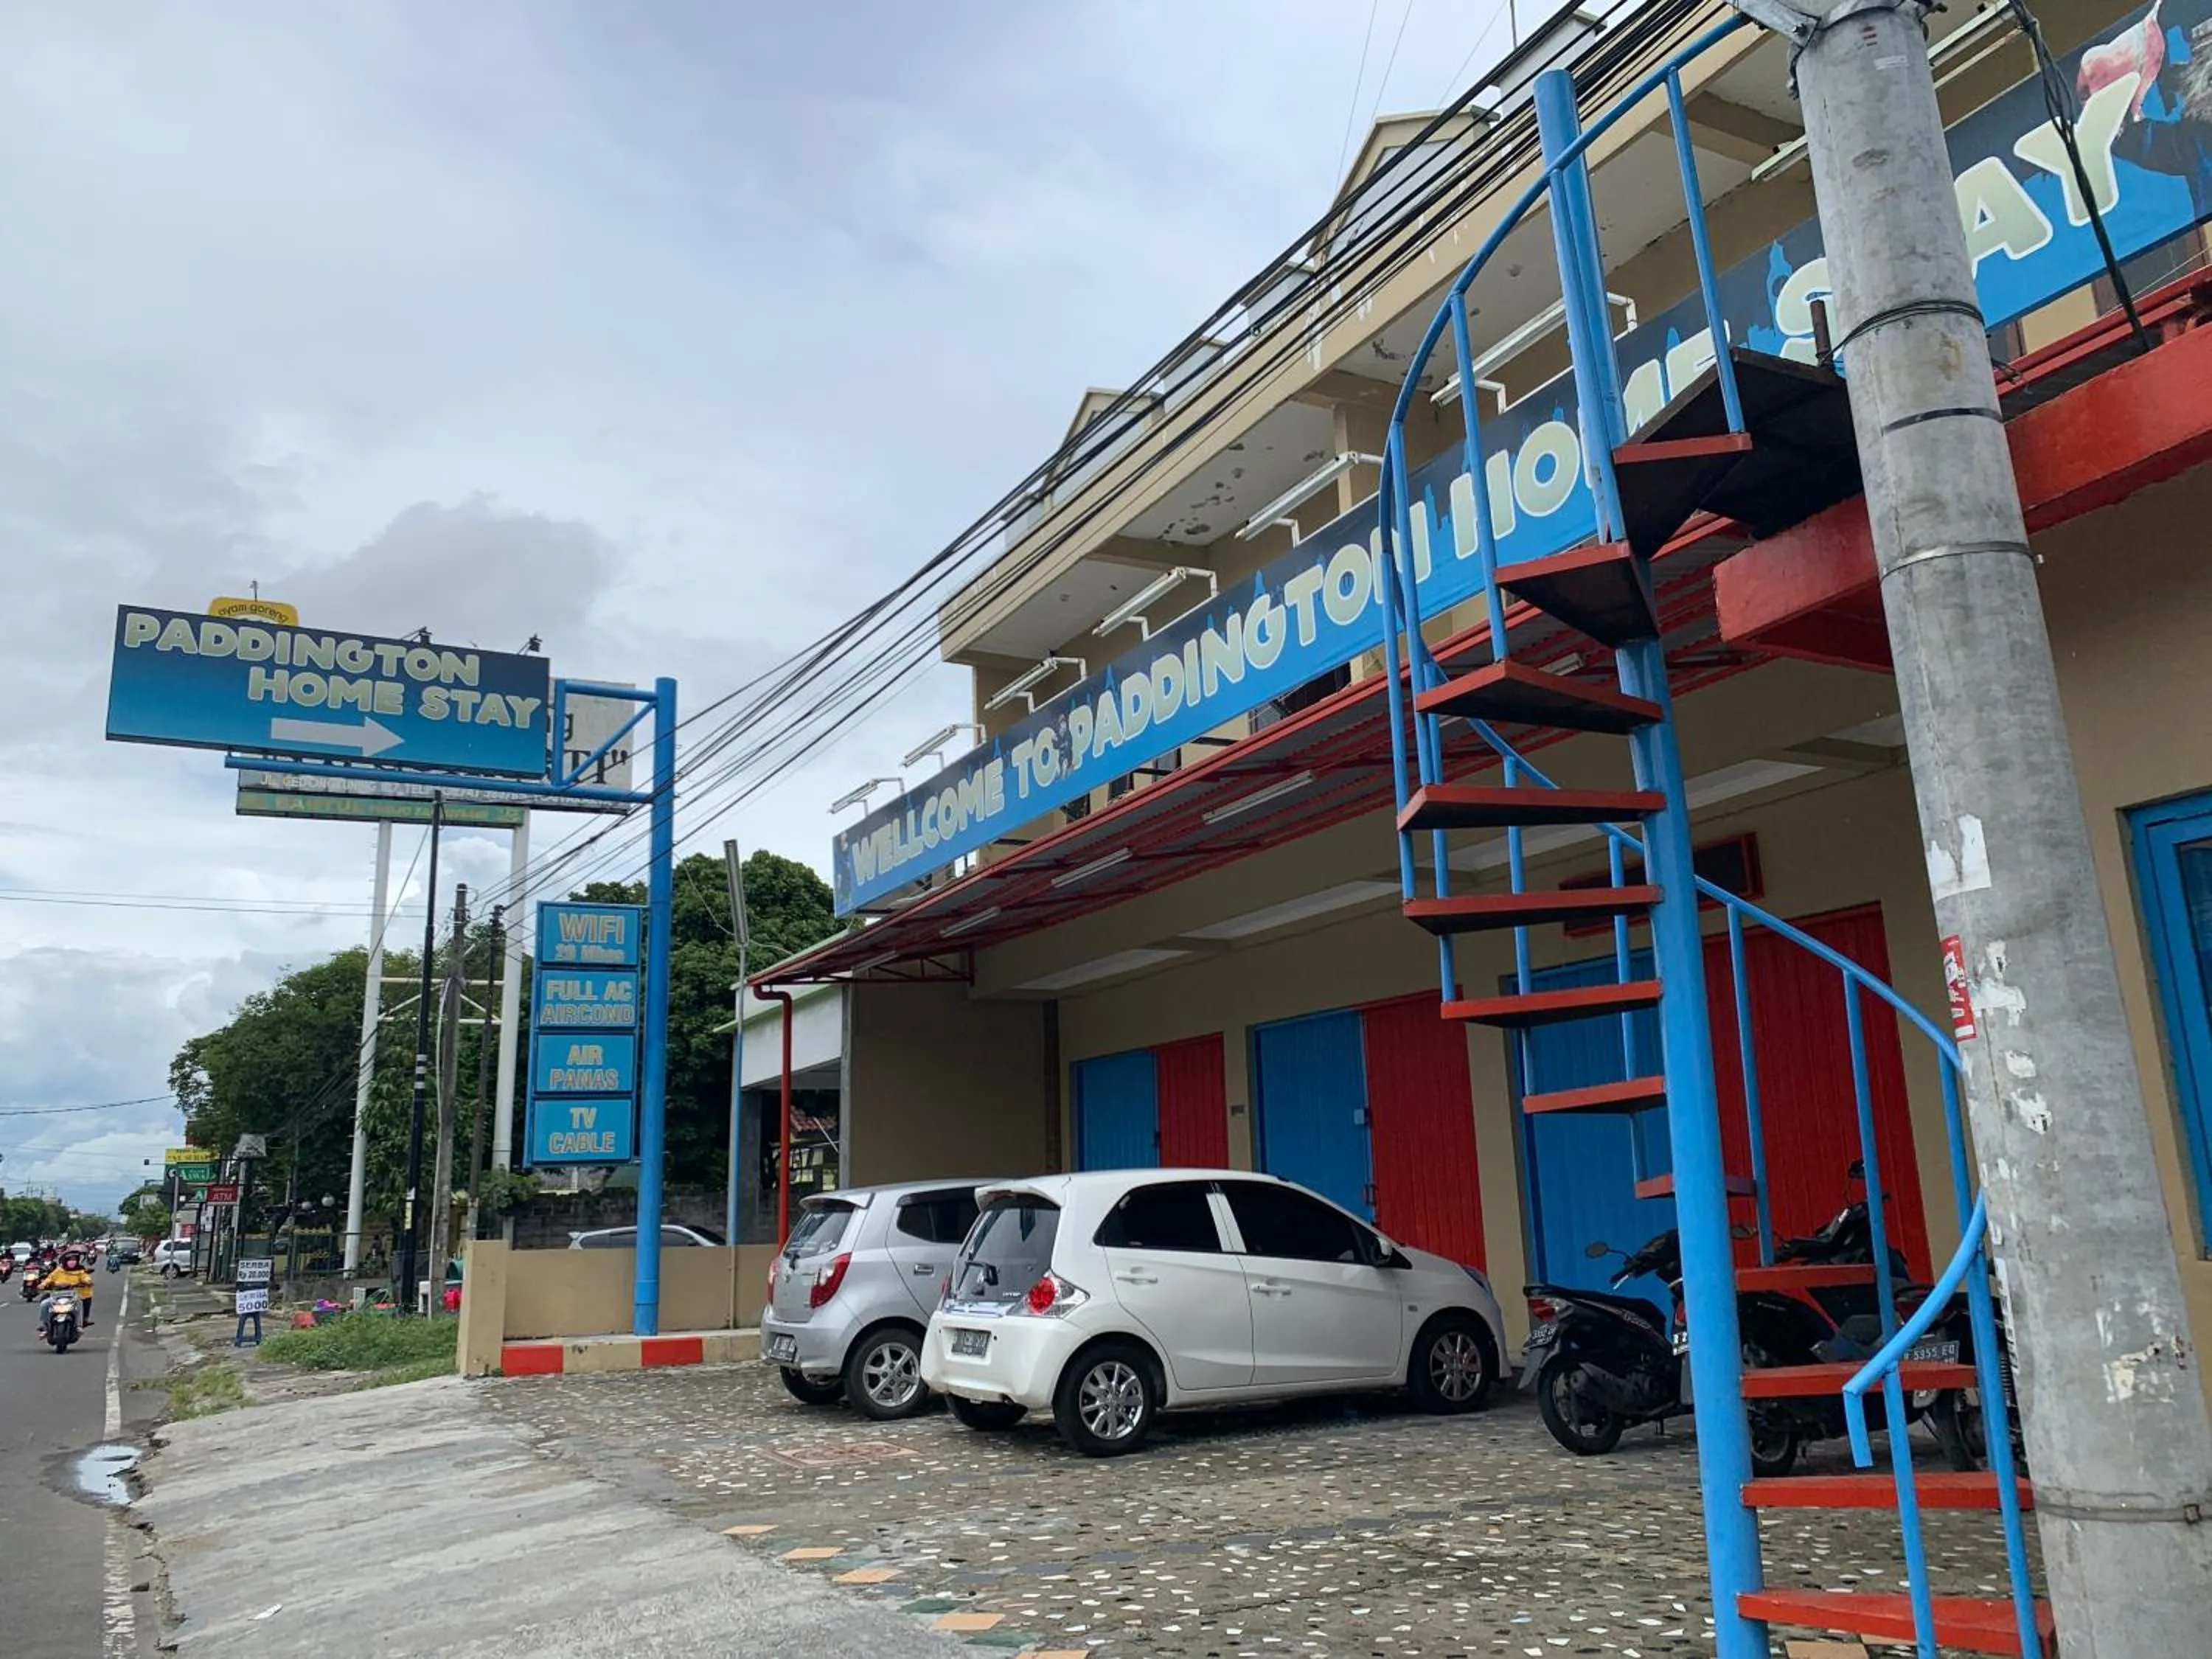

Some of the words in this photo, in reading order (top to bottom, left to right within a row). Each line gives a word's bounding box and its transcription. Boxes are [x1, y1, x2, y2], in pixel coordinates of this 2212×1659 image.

[852, 757, 1005, 886] WELLCOME
[1011, 727, 1060, 800] TO
[1068, 501, 1432, 772] PADDINGTON
[1449, 319, 1731, 560] HO
[124, 613, 480, 686] PADDINGTON
[248, 667, 405, 716] HOME
[419, 686, 541, 729] STAY
[558, 913, 625, 945] WIFI
[546, 979, 597, 1001] FULL
[603, 981, 633, 1001] AC
[542, 1004, 635, 1025] AIRCOND
[566, 1044, 603, 1066] AIR
[549, 1068, 619, 1090] PANAS
[569, 1107, 597, 1129] TV
[548, 1131, 616, 1155] CABLE
[212, 1193, 233, 1201] ATM
[238, 1300, 268, 1311] 5000
